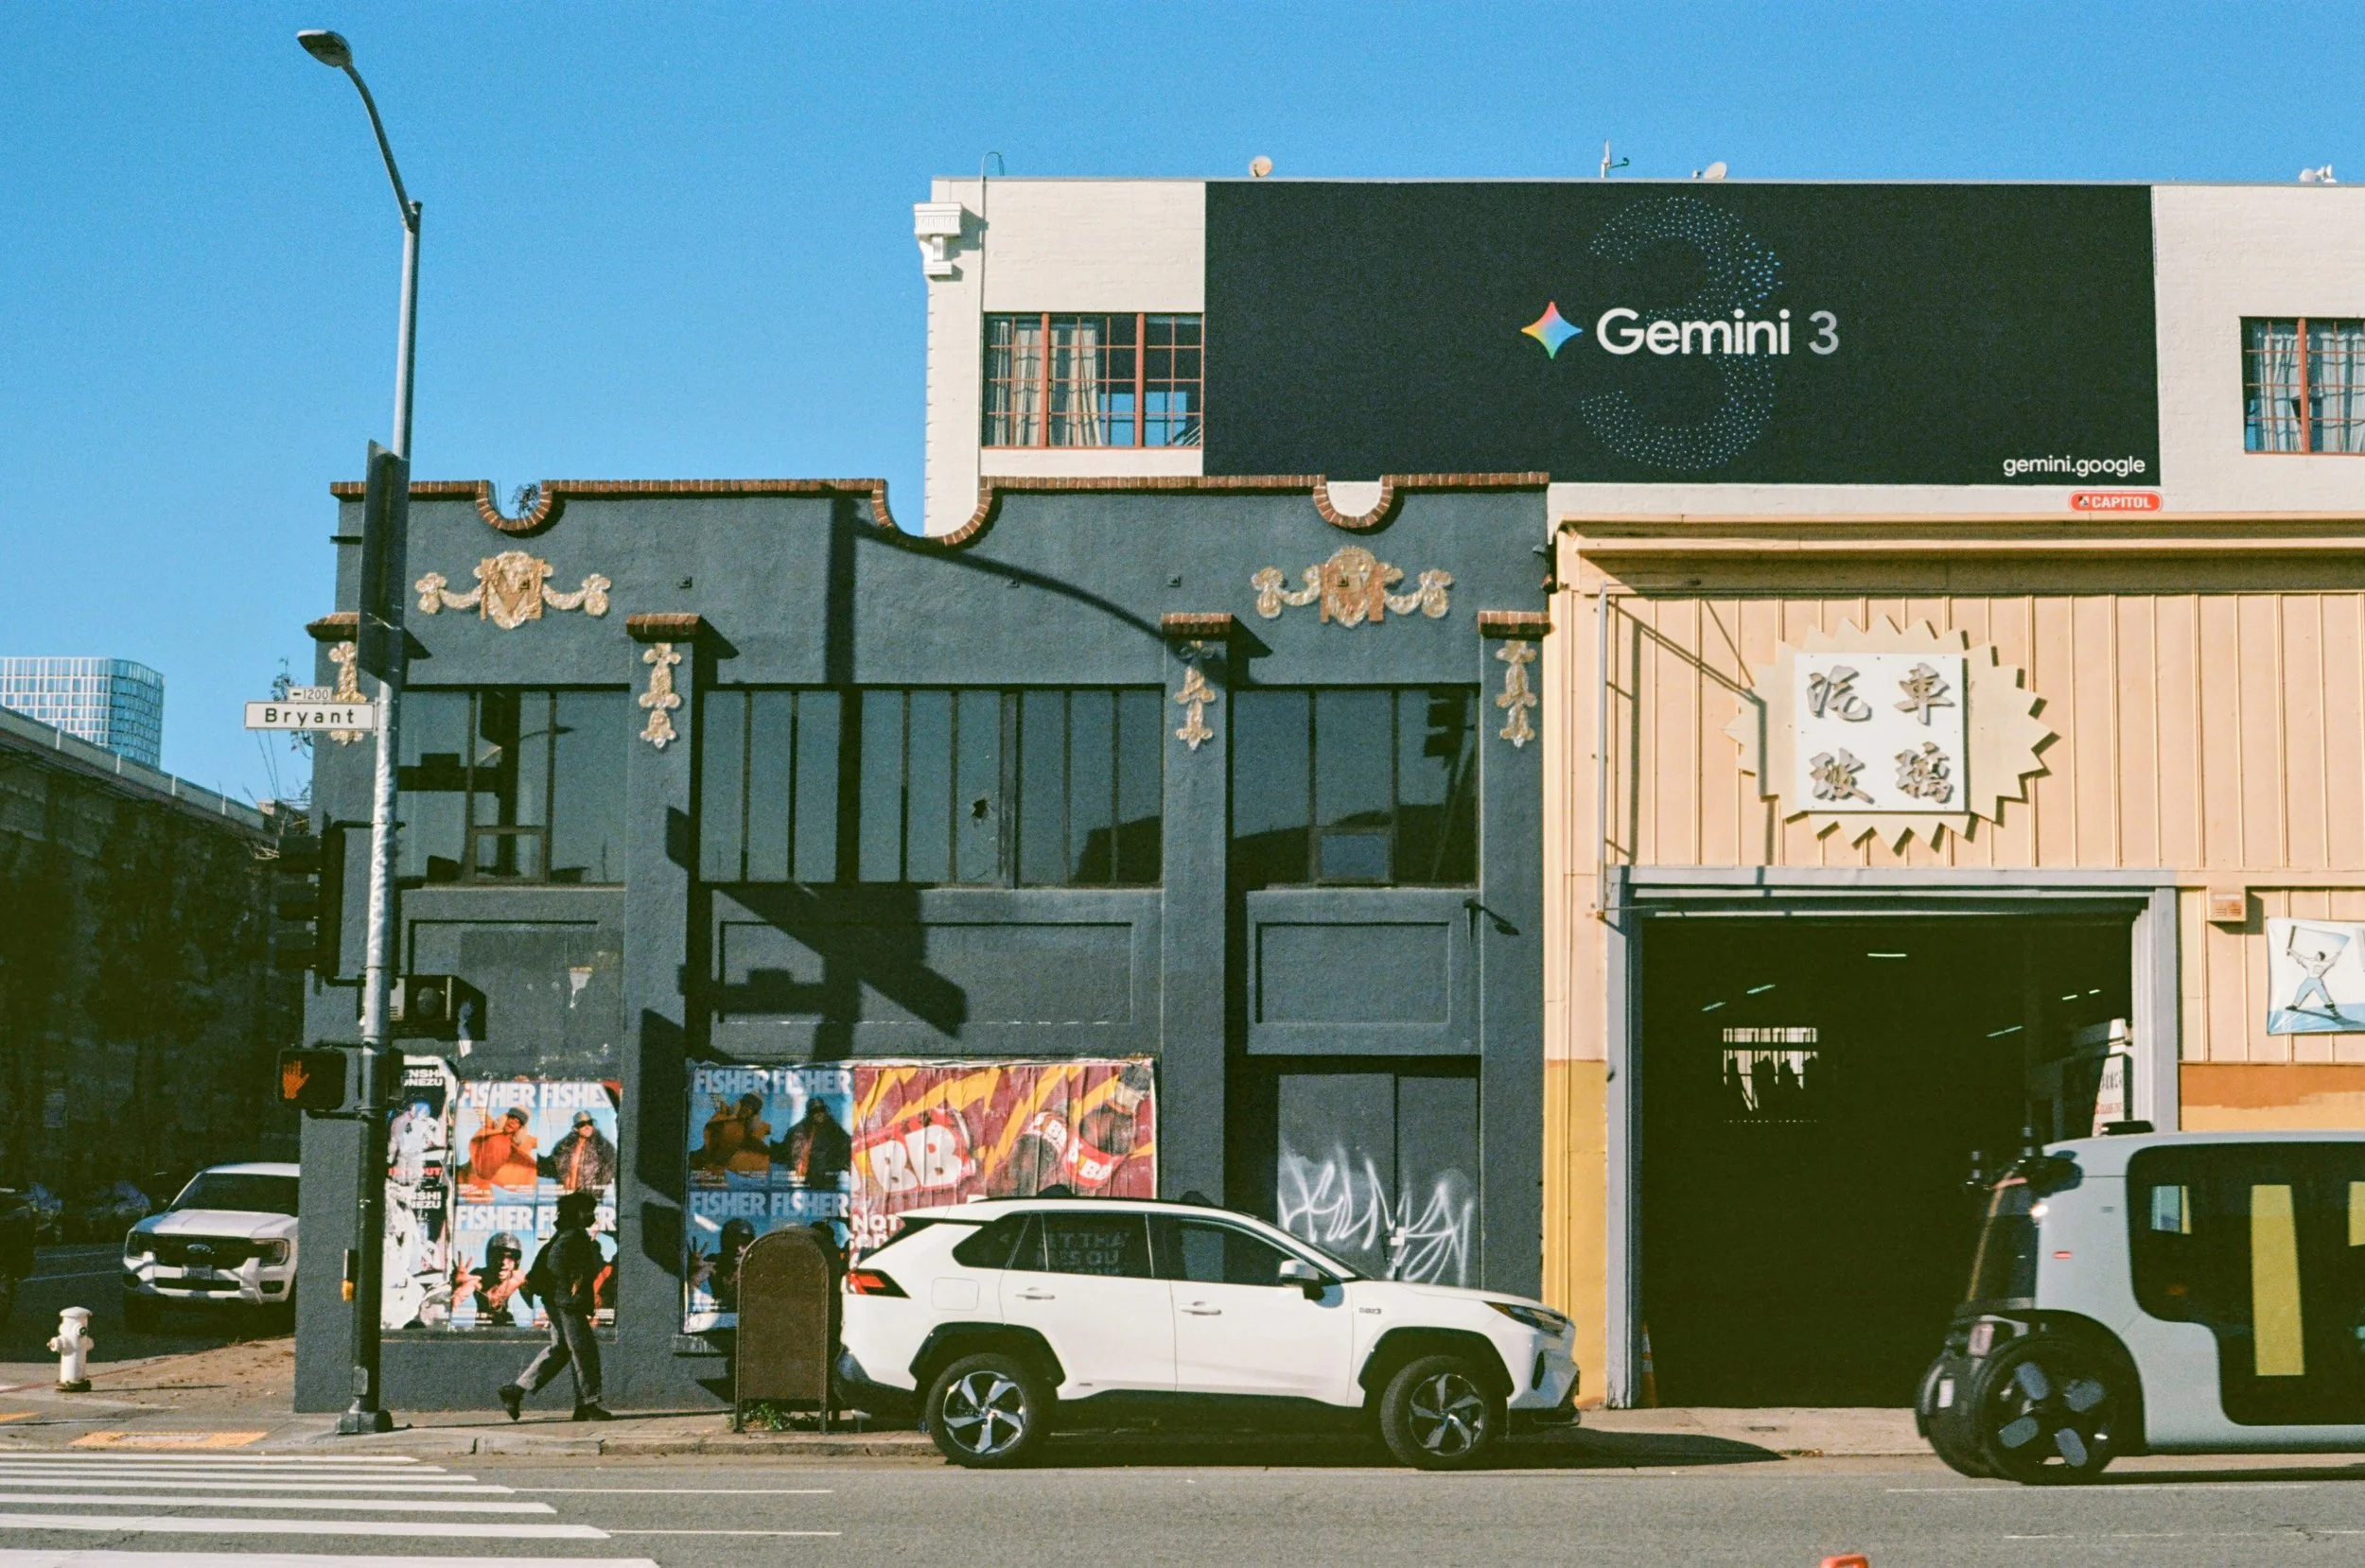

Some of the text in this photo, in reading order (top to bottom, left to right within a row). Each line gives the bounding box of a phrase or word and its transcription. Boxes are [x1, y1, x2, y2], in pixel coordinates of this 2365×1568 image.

[1596, 307, 1839, 355] Gemini 3
[2003, 455, 2146, 477] gemini.google
[2092, 496, 2152, 509] CAPITOL
[303, 689, 328, 700] 1200
[265, 707, 355, 726] Bryant
[693, 1070, 770, 1094] FISHER
[772, 1070, 851, 1095] FISHER
[691, 1192, 766, 1216] FISHER
[771, 1191, 850, 1217] FISHER
[456, 1205, 534, 1231] FISHER
[851, 1213, 900, 1231] NOT
